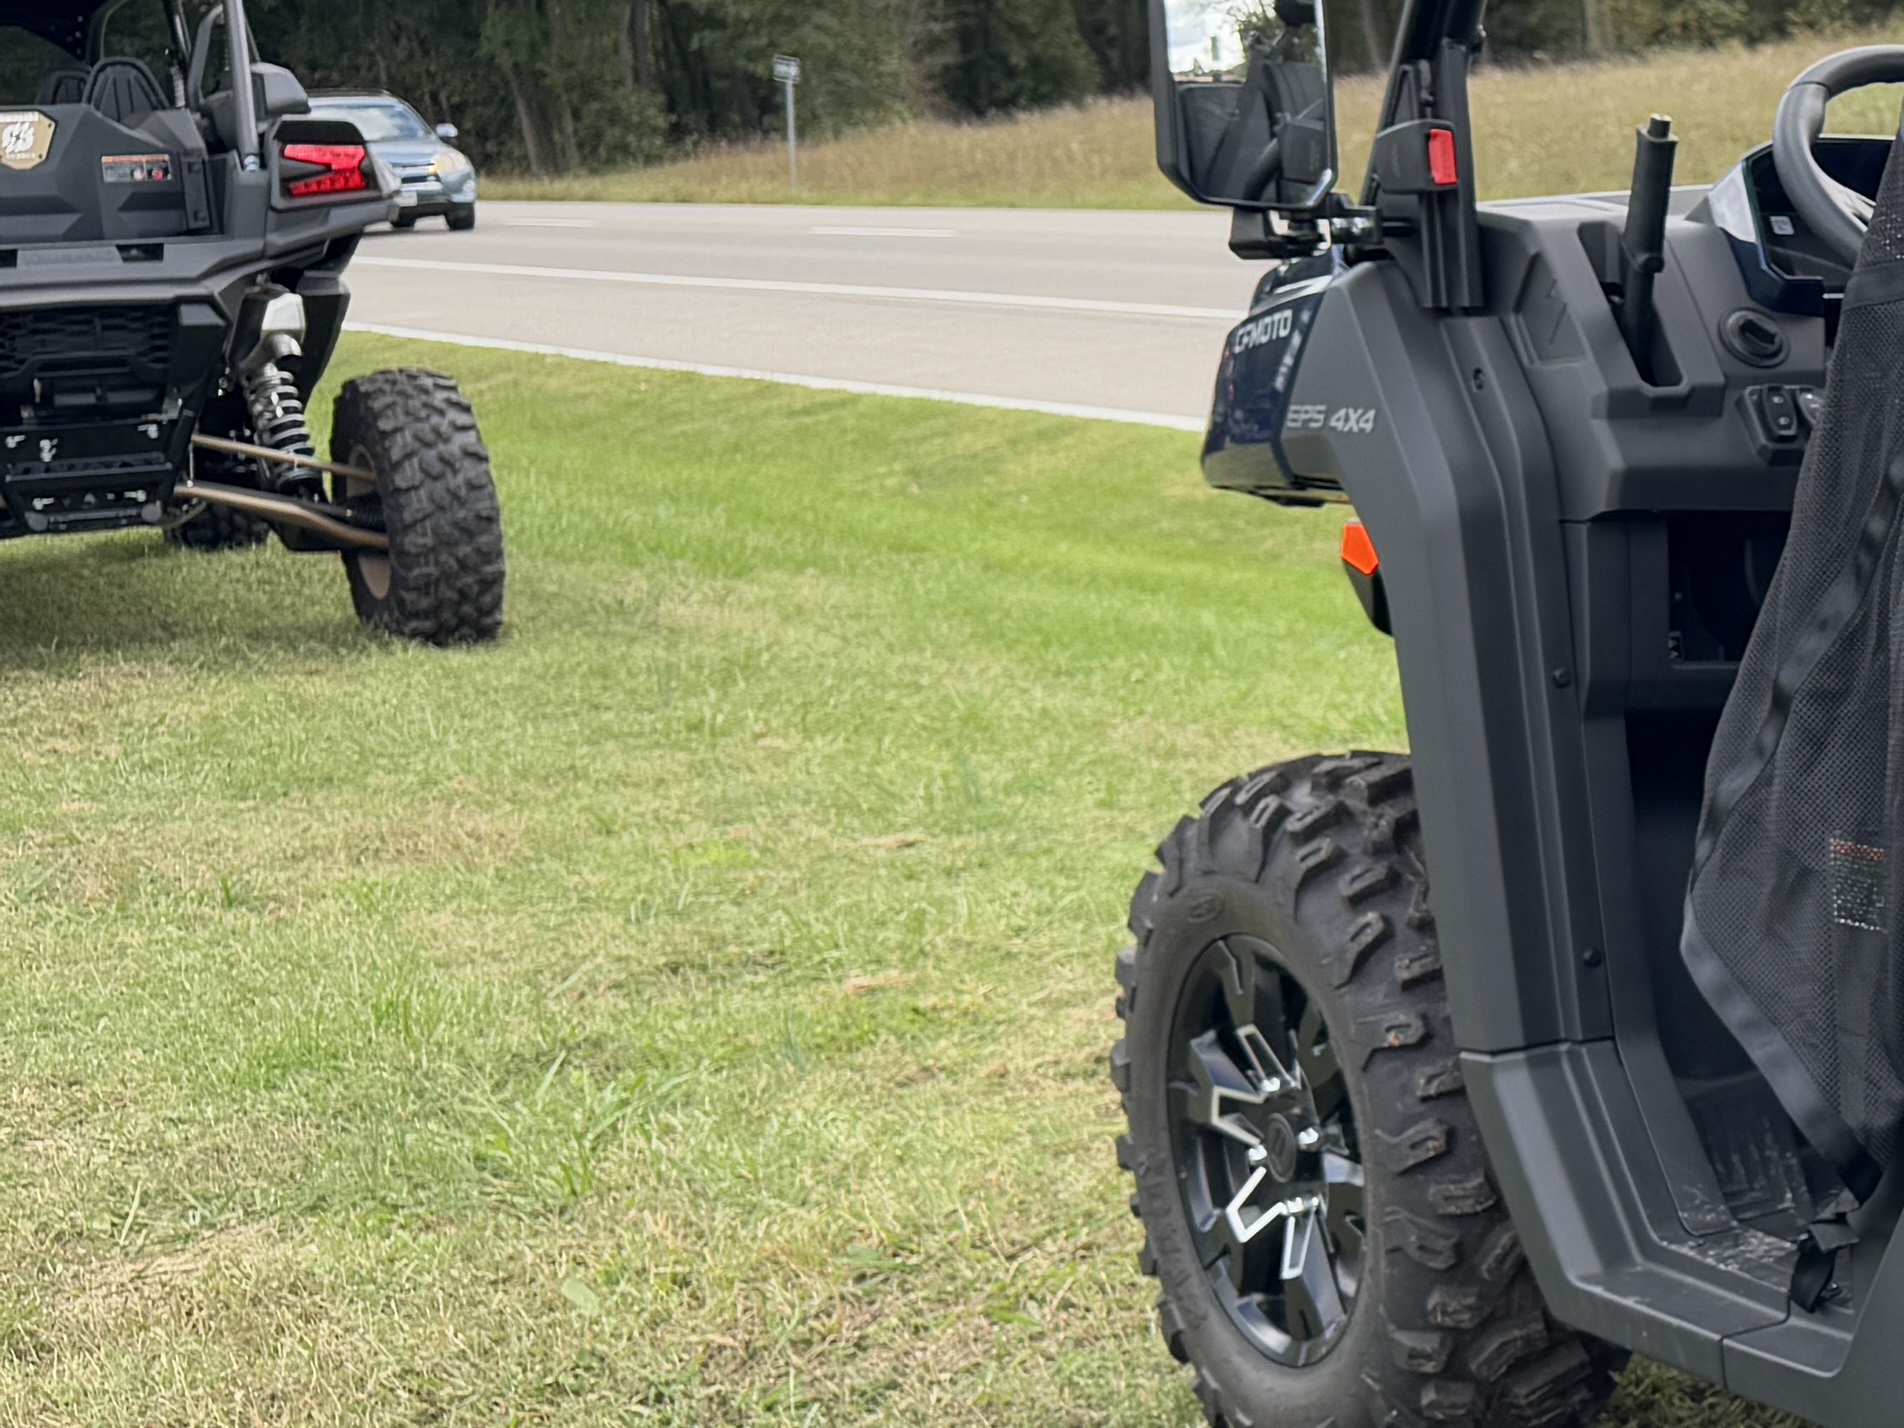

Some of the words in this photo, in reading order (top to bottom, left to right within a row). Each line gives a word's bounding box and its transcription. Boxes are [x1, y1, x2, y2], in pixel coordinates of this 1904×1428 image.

[1234, 309, 1293, 354] CFMOTO
[1287, 405, 1326, 428] EPS
[1330, 408, 1376, 433] 4X4
